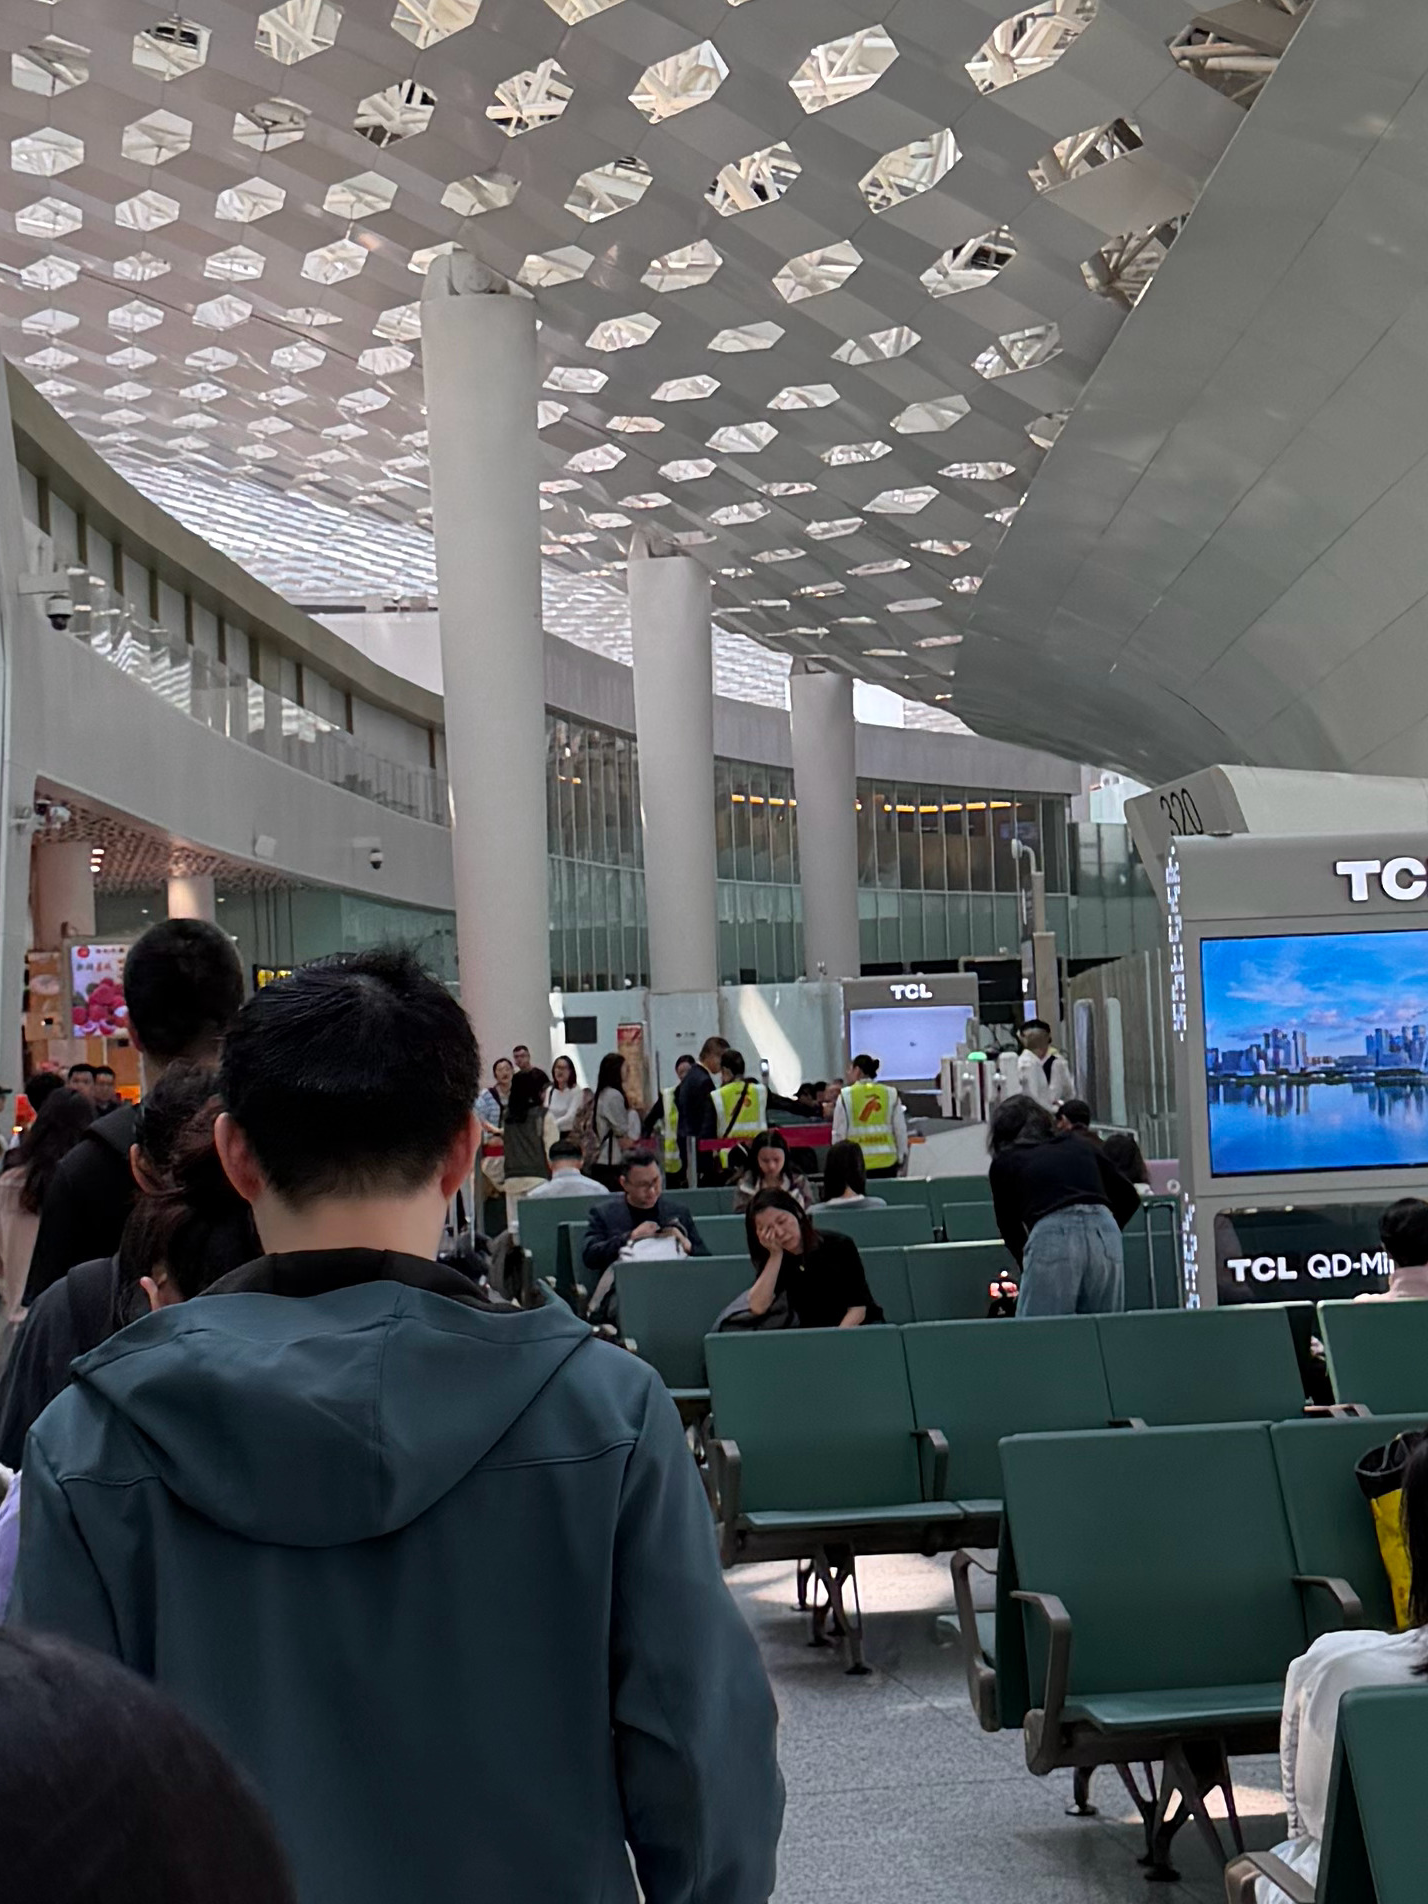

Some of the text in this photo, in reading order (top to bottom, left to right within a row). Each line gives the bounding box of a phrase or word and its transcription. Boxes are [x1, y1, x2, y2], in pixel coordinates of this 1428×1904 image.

[1159, 787, 1204, 836] 320
[890, 983, 933, 1000] TCL
[1227, 1256, 1298, 1283] TCL
